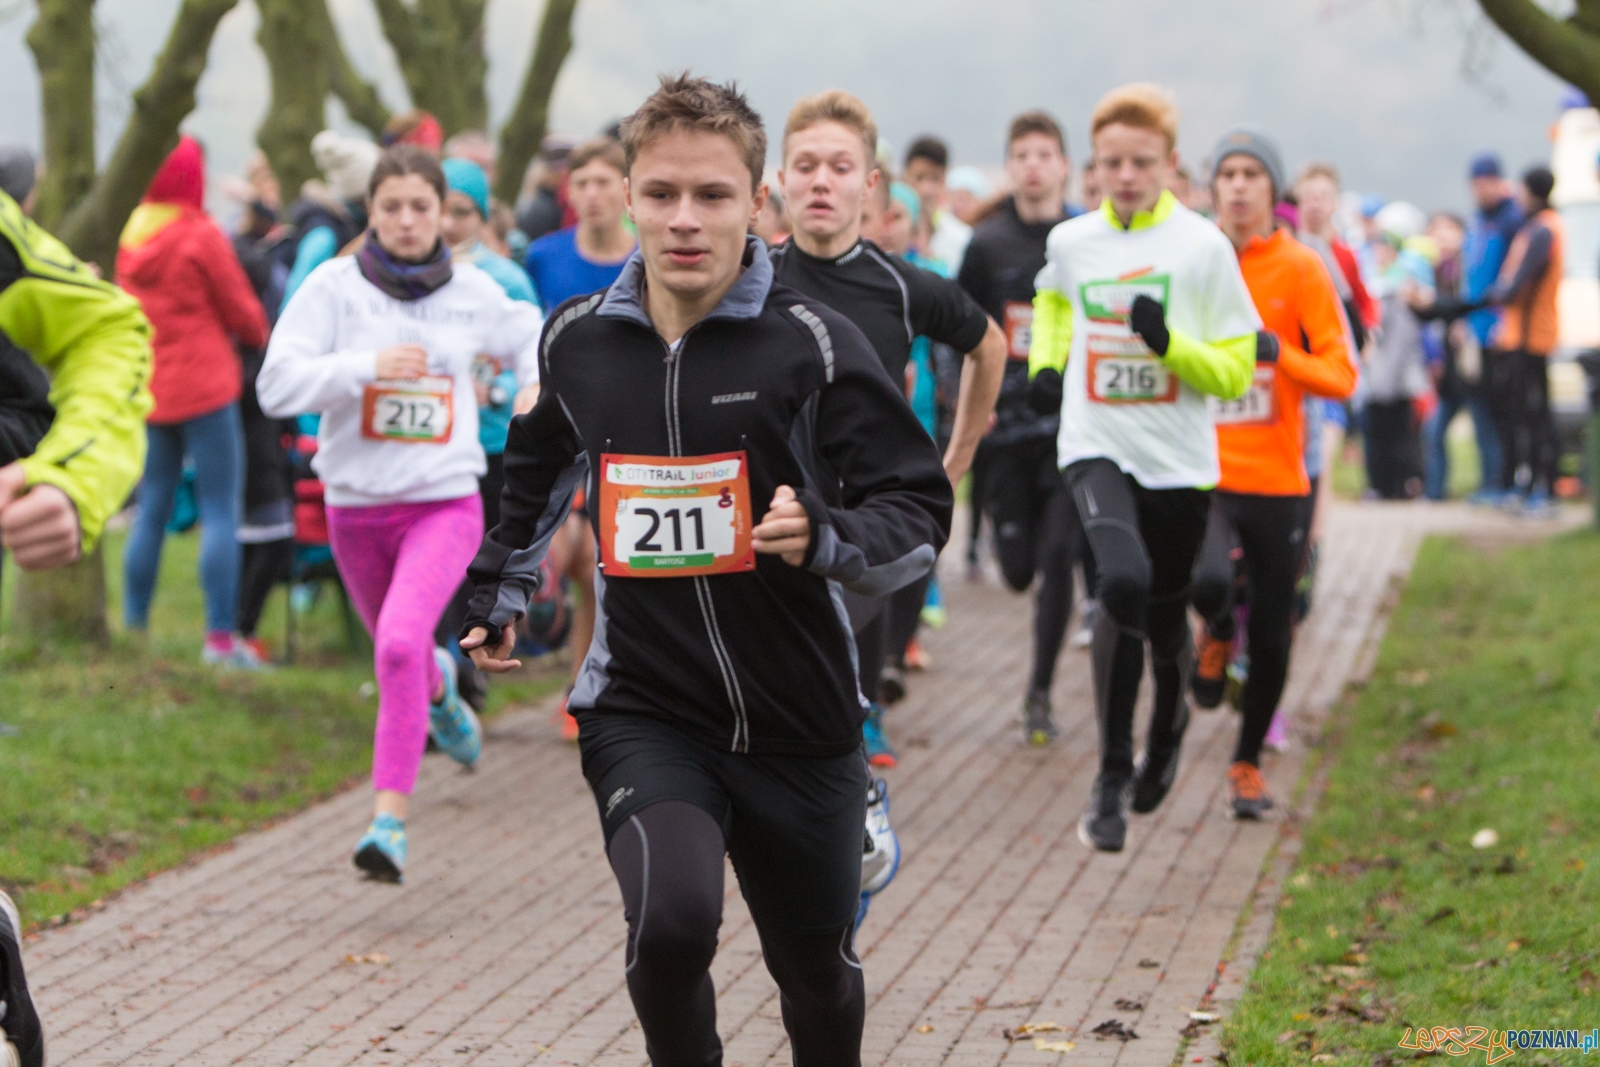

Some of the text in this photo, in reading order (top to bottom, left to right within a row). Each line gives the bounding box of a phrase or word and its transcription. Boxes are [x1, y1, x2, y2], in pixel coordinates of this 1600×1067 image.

[1105, 364, 1155, 390] 216
[385, 400, 434, 427] 212
[691, 467, 731, 480] Junior
[634, 507, 705, 551] 211
